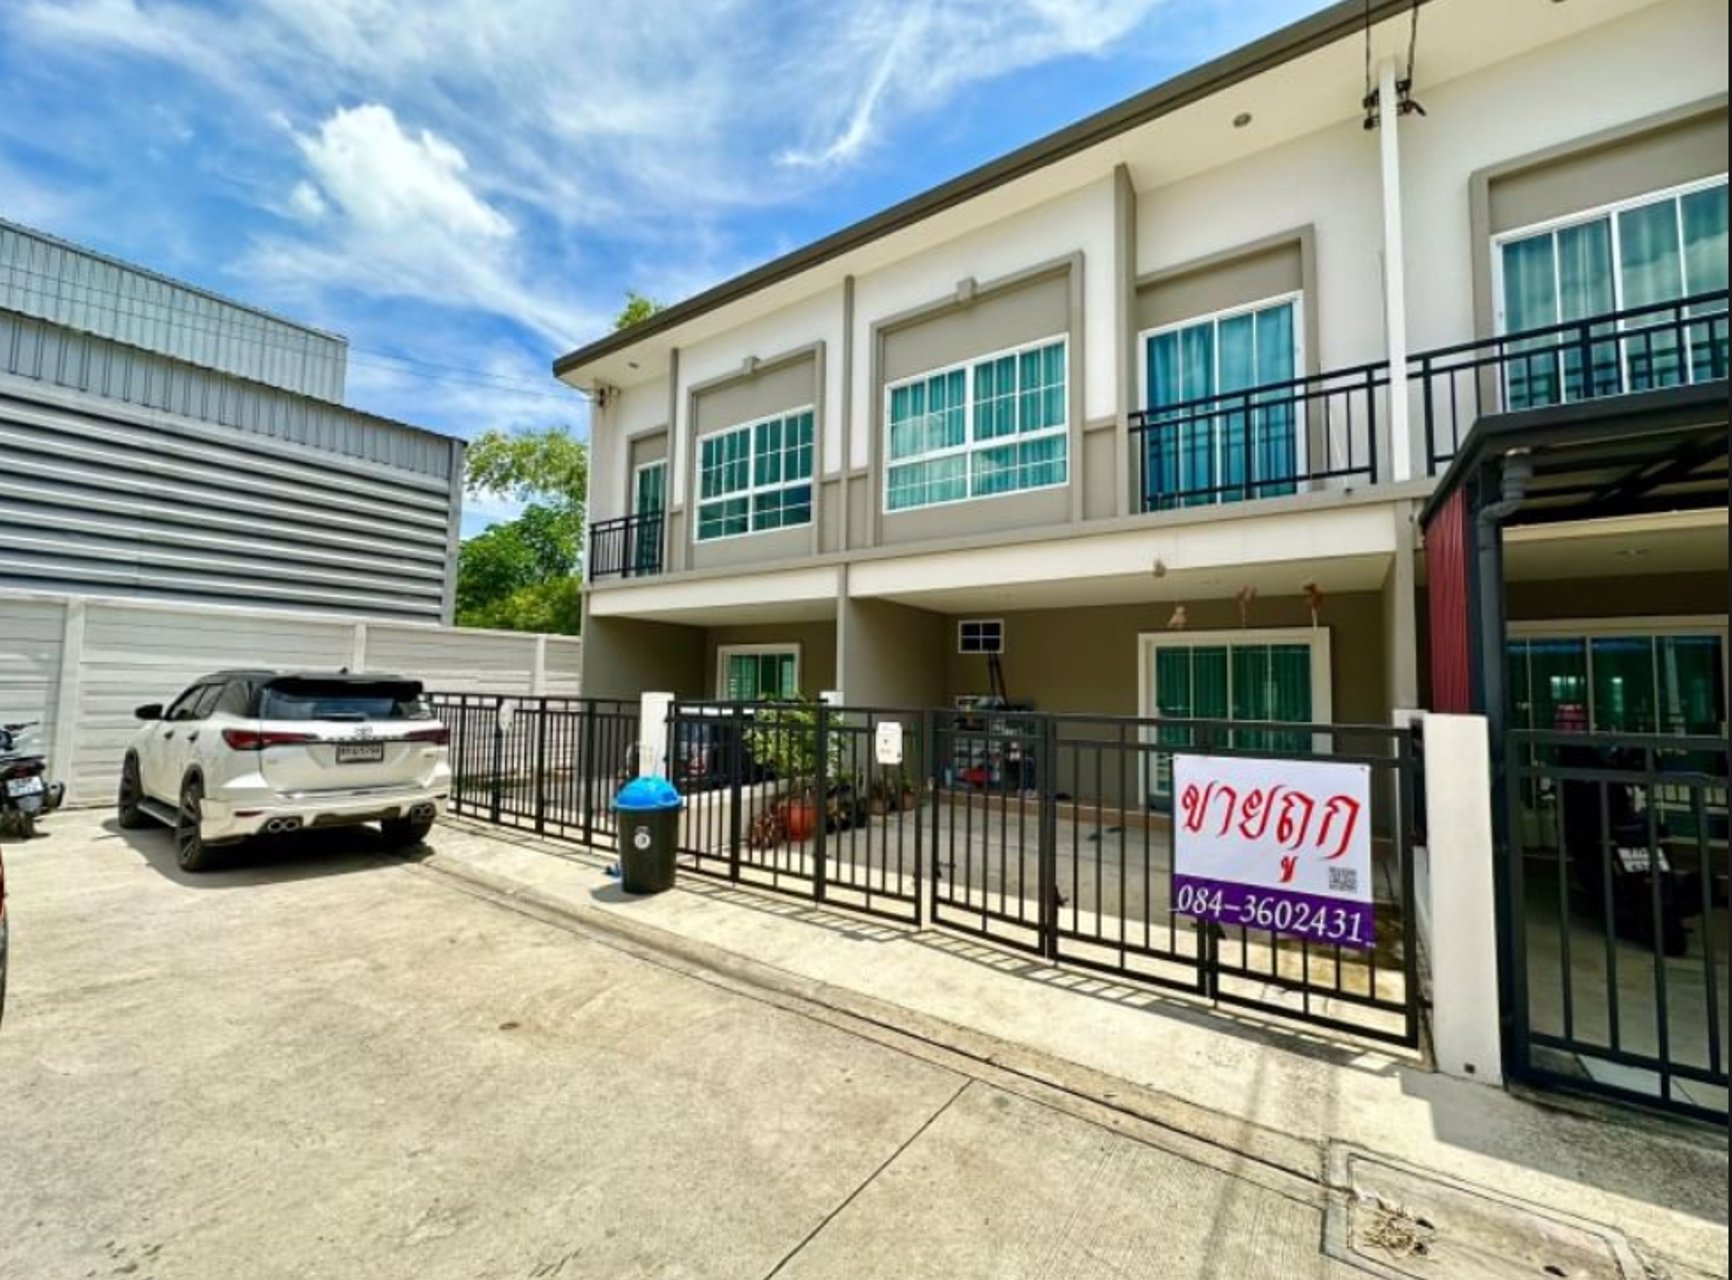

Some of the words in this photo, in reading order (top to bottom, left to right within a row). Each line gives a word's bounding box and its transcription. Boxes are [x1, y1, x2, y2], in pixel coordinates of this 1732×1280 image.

[1181, 780, 1361, 883] ขายถูก
[1178, 884, 1363, 942] 084-3602431
